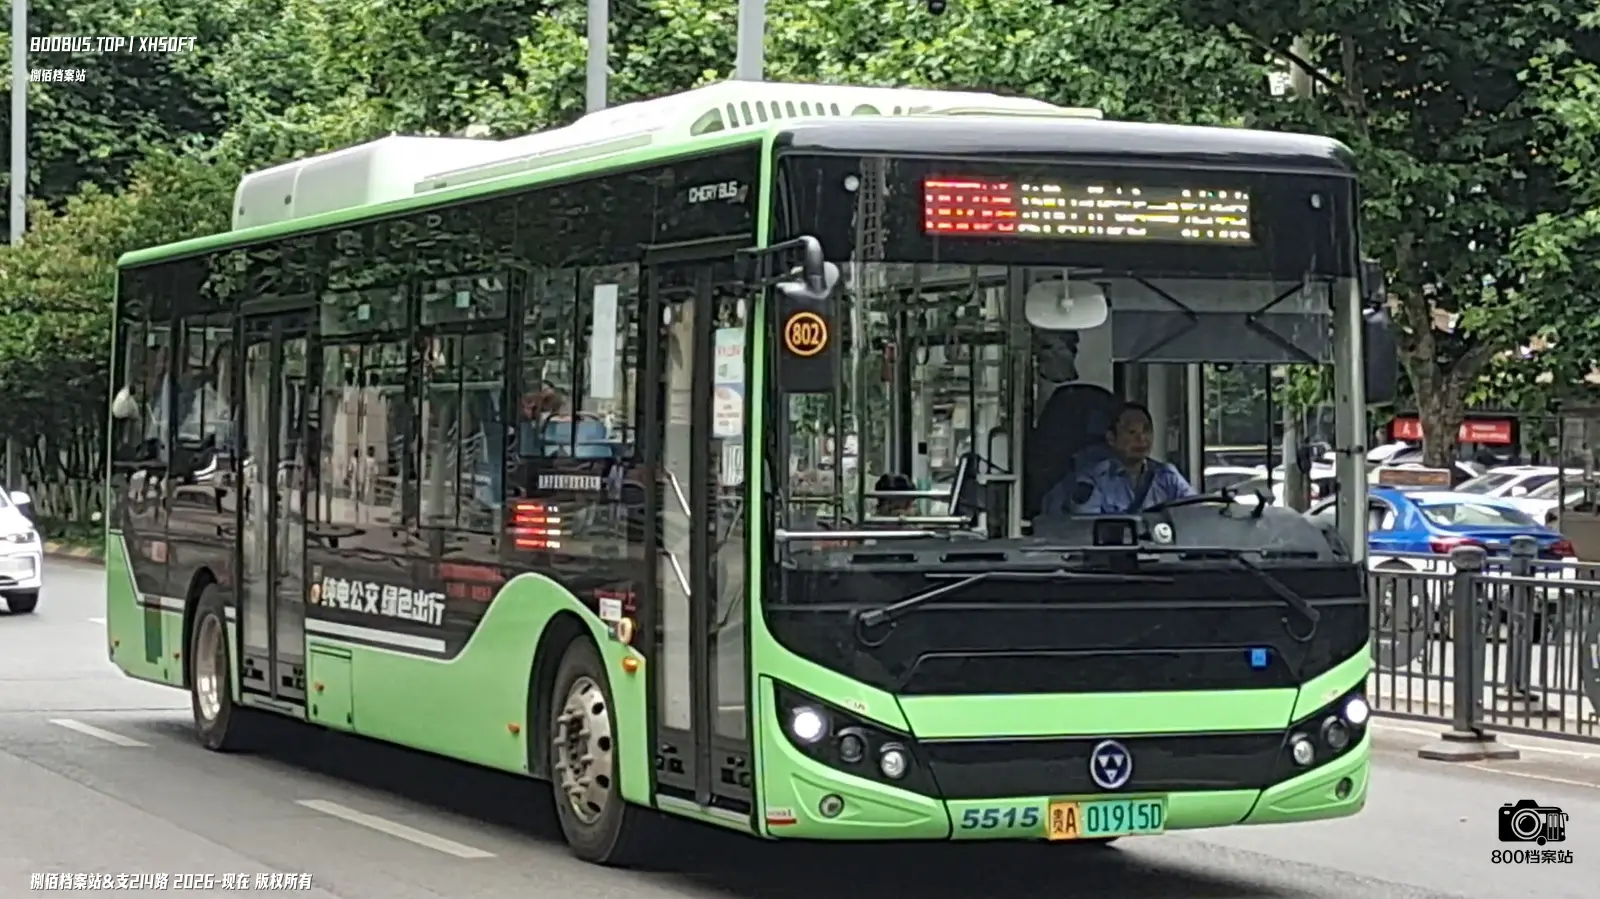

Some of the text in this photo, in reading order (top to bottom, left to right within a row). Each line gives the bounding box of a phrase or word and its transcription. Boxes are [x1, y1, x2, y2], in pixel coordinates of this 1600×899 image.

[791, 322, 820, 346] 802
[321, 576, 446, 626] 纯电公交 绿色出行
[961, 807, 1040, 829] 5515
[1087, 802, 1162, 832] 01915D
